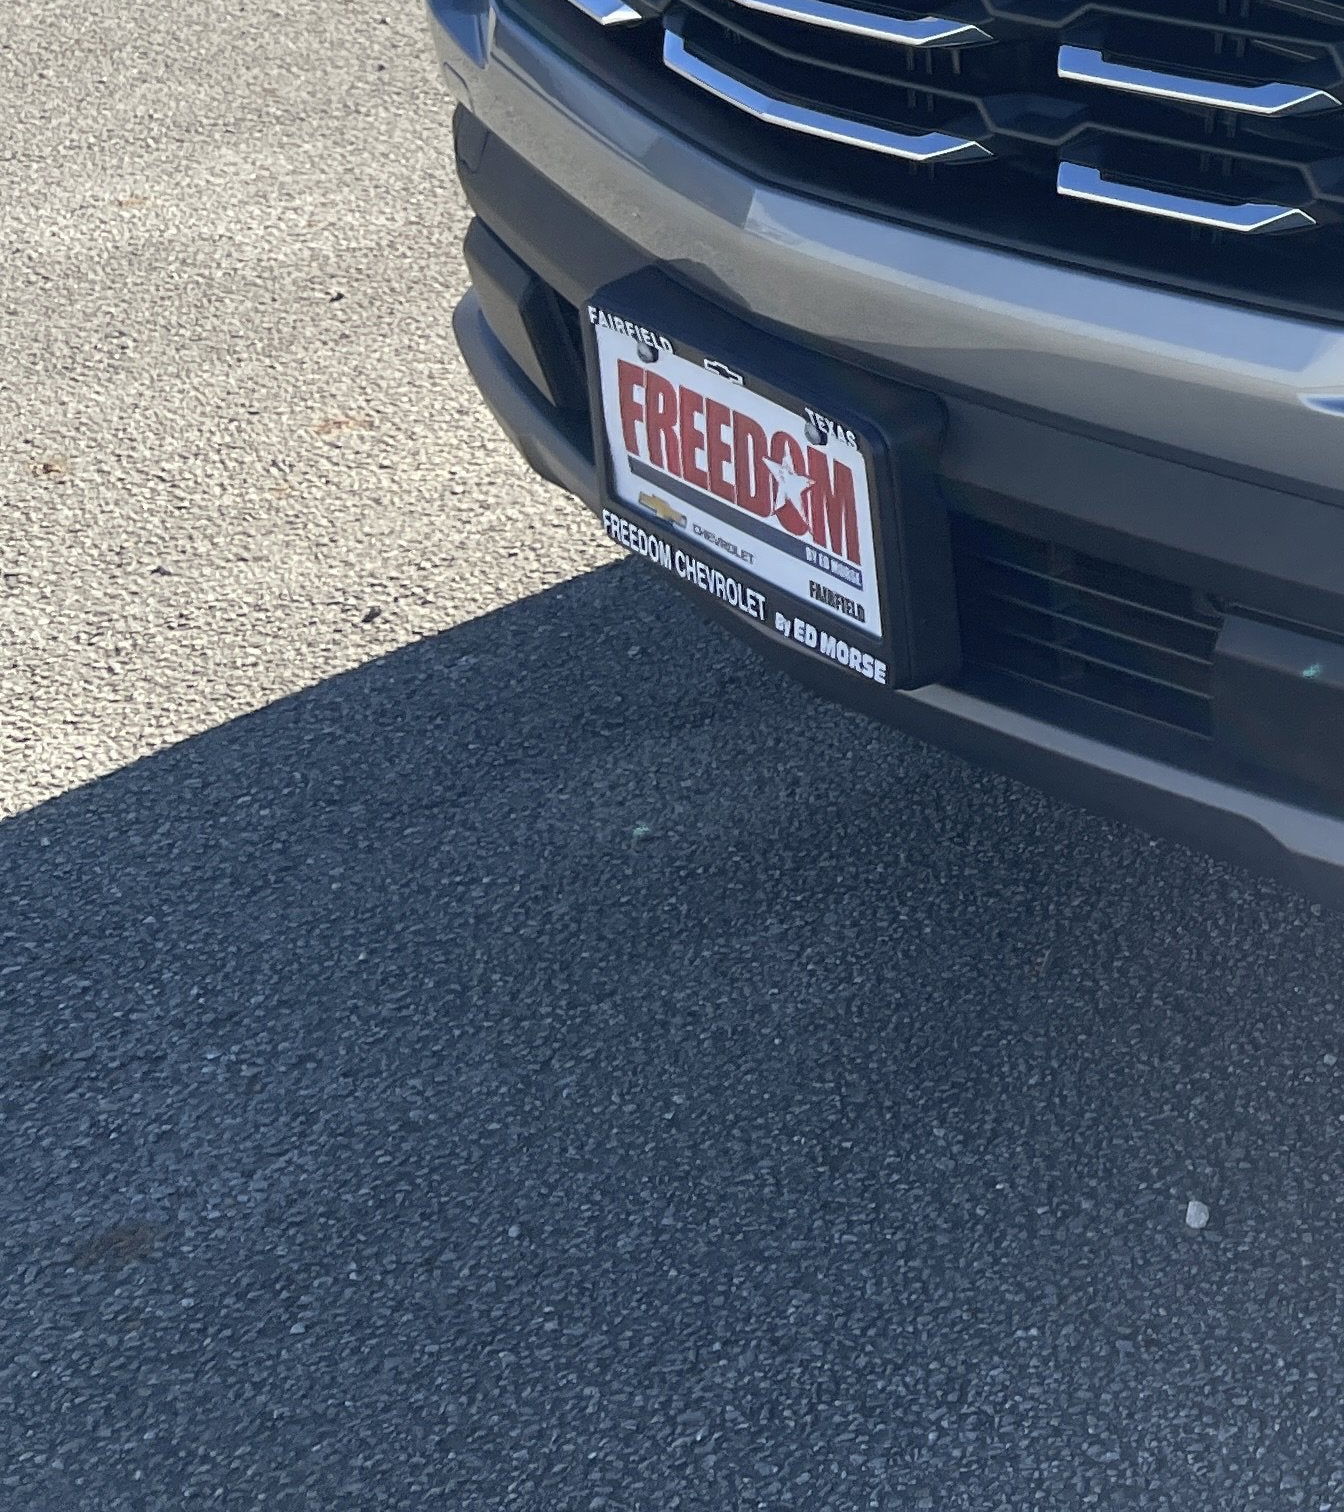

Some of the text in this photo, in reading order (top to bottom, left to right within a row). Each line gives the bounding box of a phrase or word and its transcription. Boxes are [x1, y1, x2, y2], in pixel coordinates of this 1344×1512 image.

[587, 304, 859, 450] FAIRFIELD TEXAS
[617, 357, 862, 566] FREEDOM
[602, 507, 673, 571] FREEDOM
[674, 549, 767, 621] CHEVROLET
[793, 617, 818, 648] ED
[820, 630, 887, 685] MORSE
[692, 522, 755, 565] CHEVROLET
[808, 579, 866, 624] FAIRFIELD
